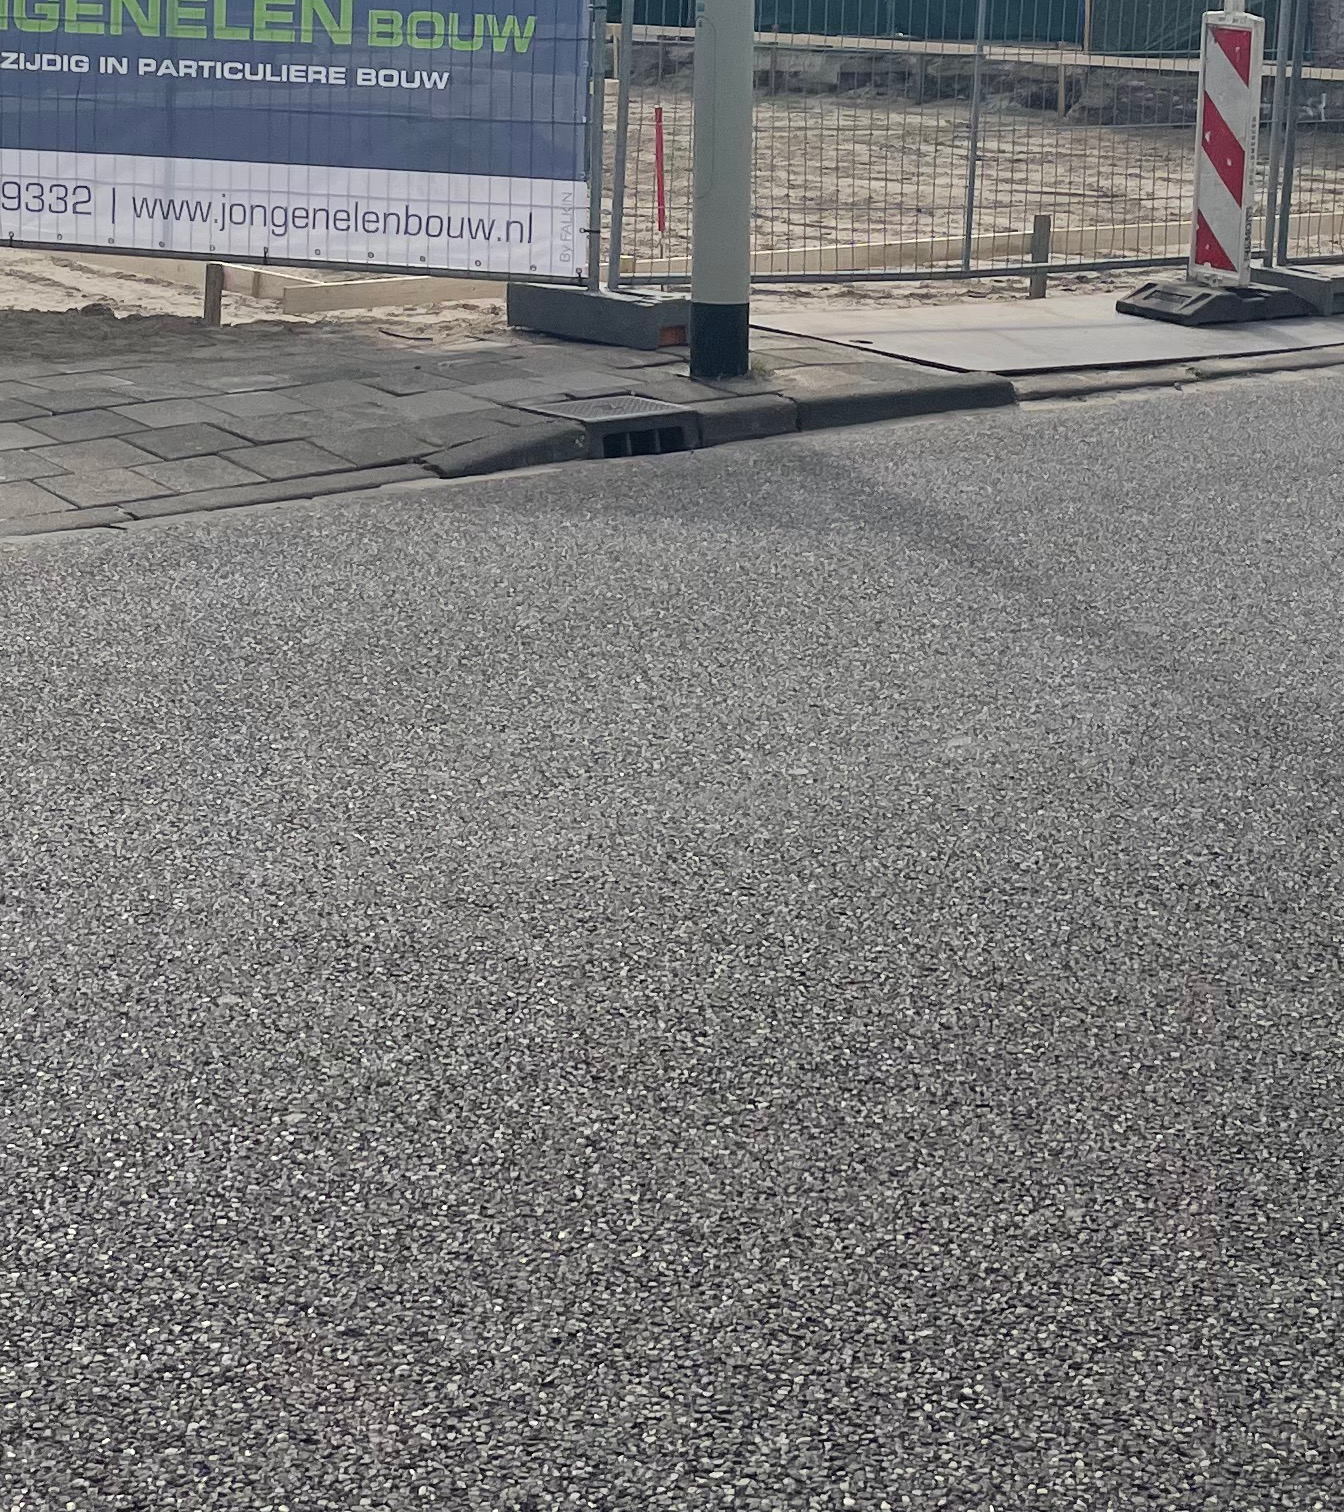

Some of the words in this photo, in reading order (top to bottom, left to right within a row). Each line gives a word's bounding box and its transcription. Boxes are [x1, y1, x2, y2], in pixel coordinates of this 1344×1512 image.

[367, 9, 538, 53] BOUW
[99, 56, 128, 75] IN
[138, 58, 347, 85] PARTICULIERE
[356, 67, 450, 90] BOUW
[132, 192, 533, 245] www.jongenelenbouw.nl
[560, 191, 573, 242] FALKIN
